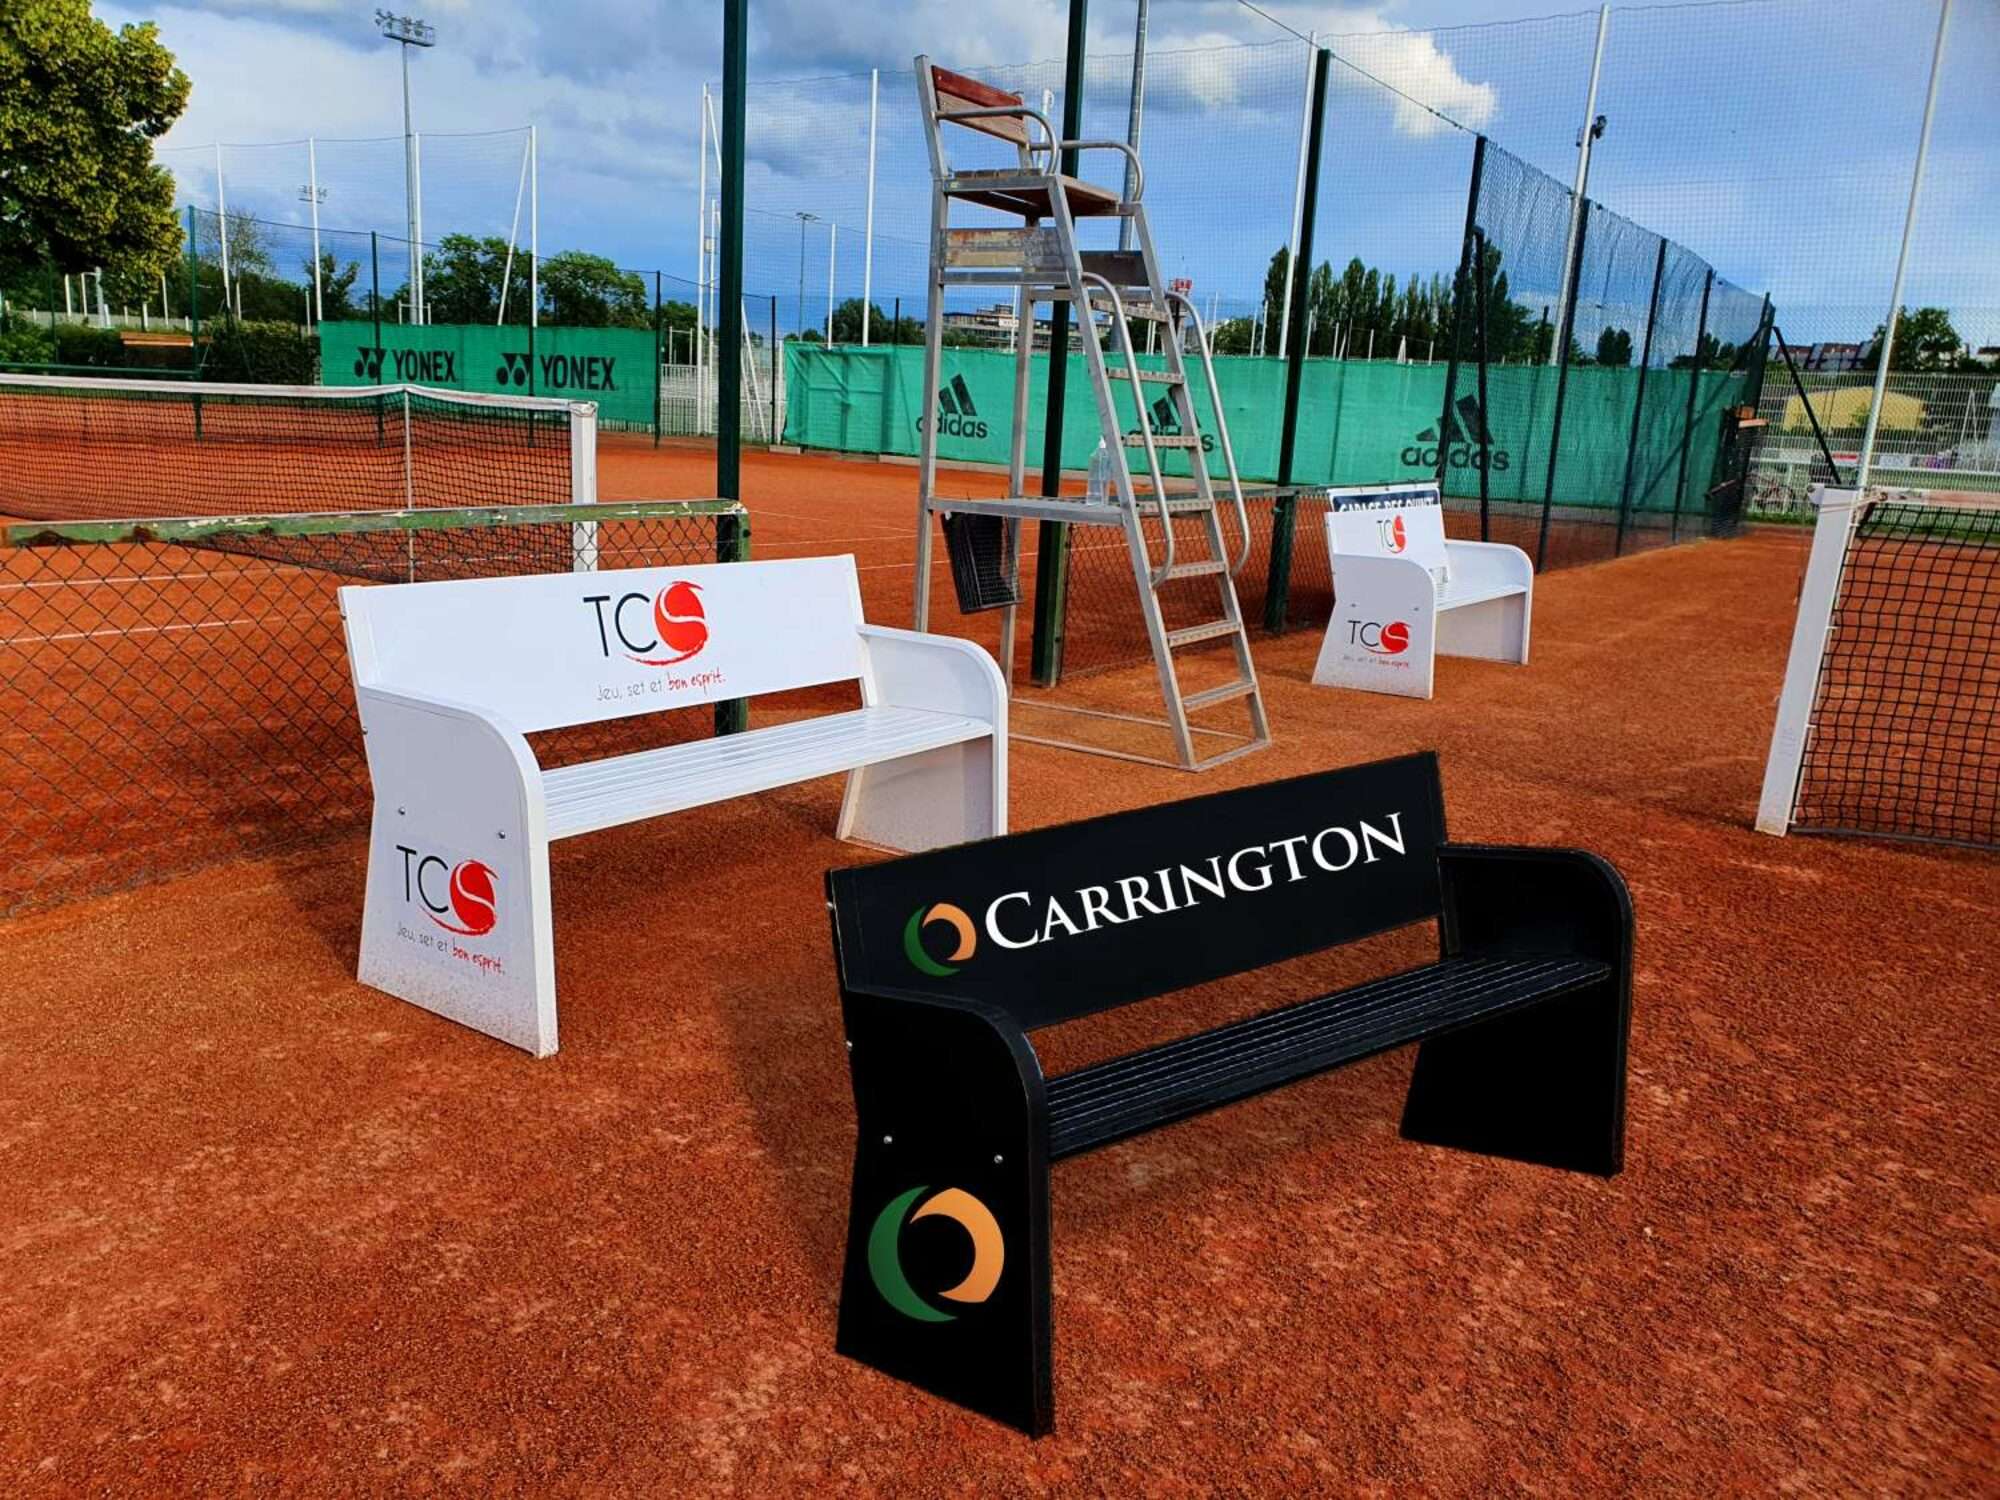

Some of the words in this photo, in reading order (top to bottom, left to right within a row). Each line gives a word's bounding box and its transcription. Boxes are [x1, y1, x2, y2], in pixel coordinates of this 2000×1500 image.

[392, 349, 457, 383] YONEX
[540, 354, 617, 391] YONEX
[1401, 442, 1510, 471] addas
[666, 671, 688, 691] bon
